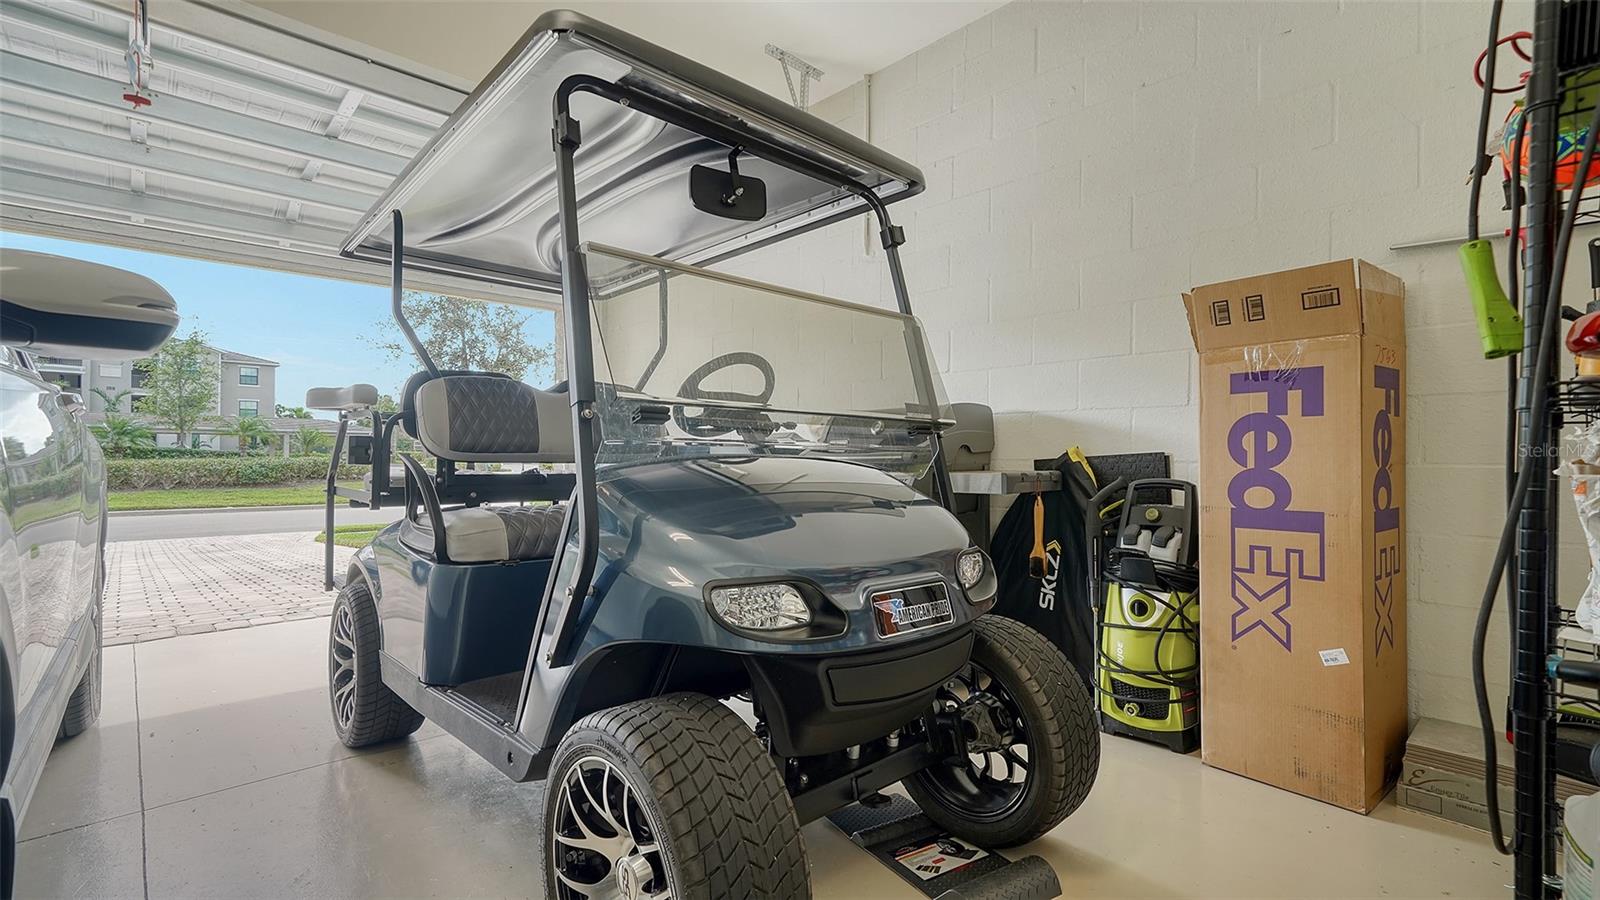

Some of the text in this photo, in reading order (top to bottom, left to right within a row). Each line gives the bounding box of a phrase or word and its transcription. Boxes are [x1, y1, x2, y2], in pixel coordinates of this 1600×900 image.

[1039, 552, 1060, 611] SKLZ
[1227, 365, 1325, 653] FedEx
[1373, 364, 1400, 659] FedEx
[898, 600, 950, 624] AMERICAN PRIDE
